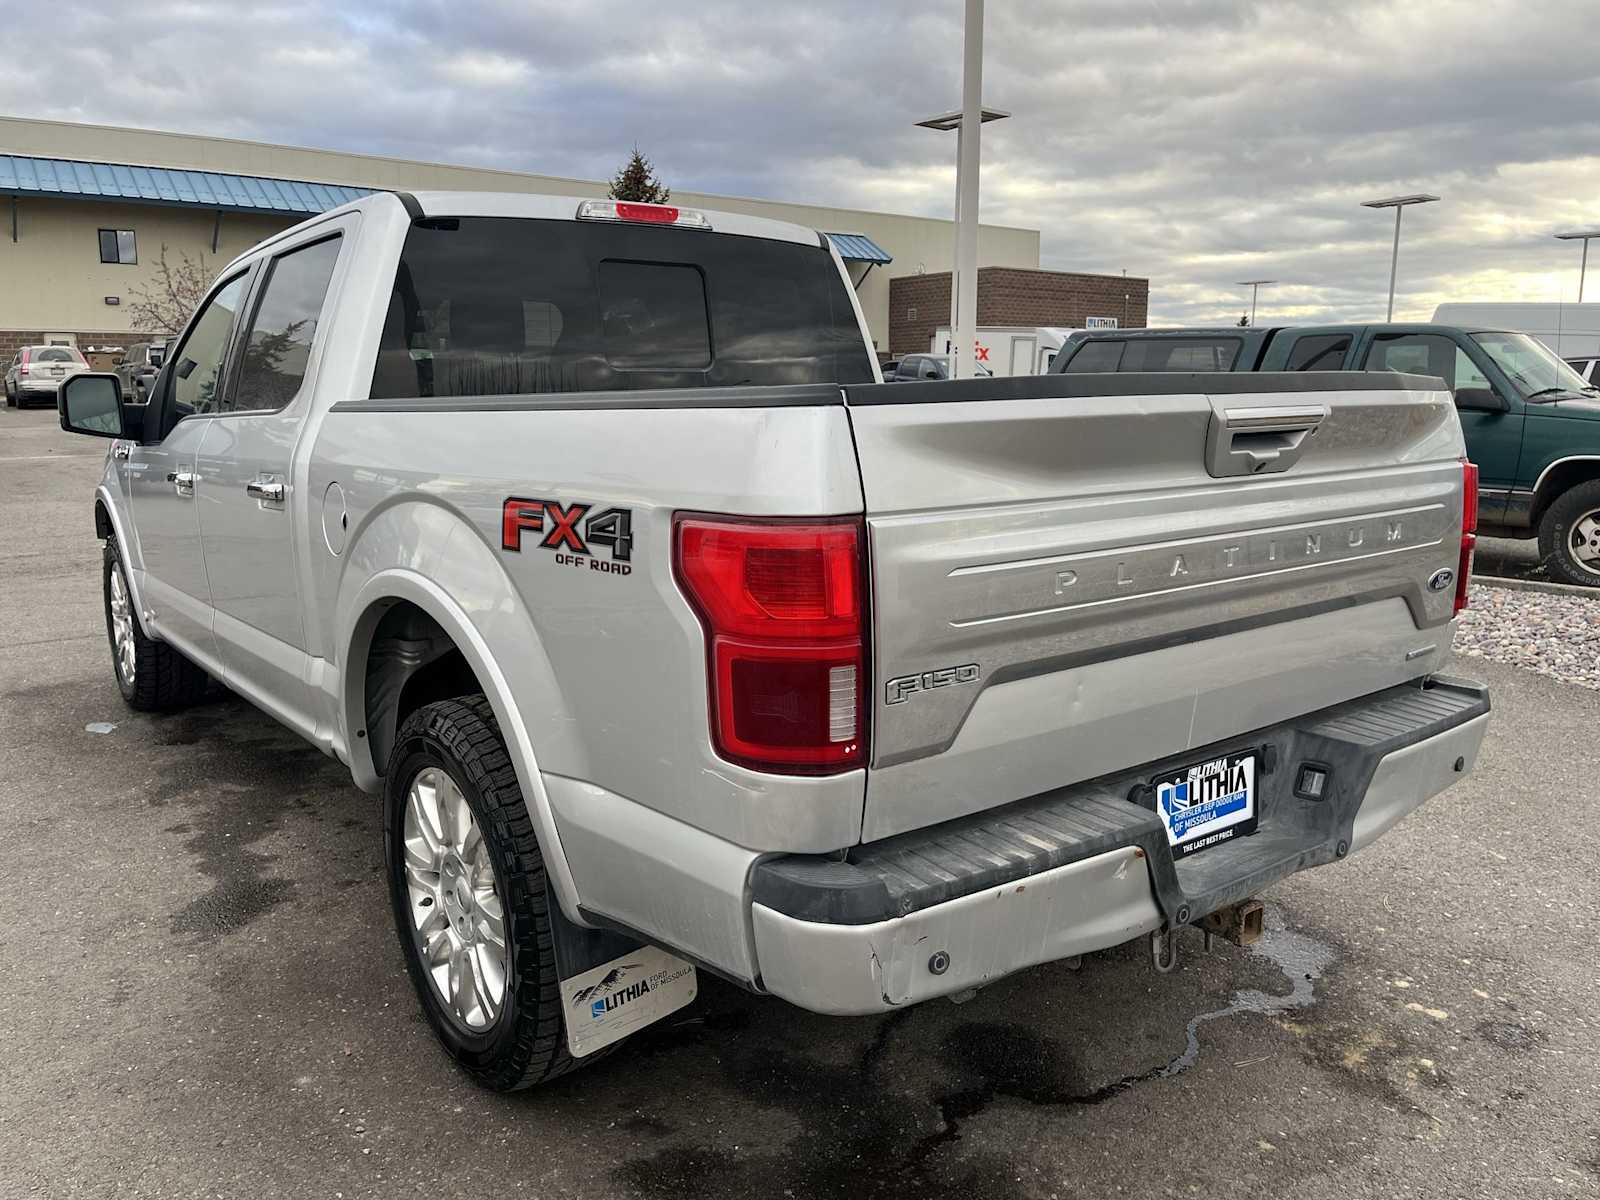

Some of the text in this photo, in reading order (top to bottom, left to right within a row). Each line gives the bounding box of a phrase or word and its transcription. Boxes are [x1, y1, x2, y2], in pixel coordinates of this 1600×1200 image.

[1094, 319, 1116, 329] LITHIA
[502, 496, 633, 562] FX4
[555, 553, 632, 576] OFF ROAD
[1055, 522, 1402, 594] PLATINUM
[1197, 758, 1228, 779] LITHIA
[1189, 765, 1248, 808] LITHIA
[1174, 806, 1202, 822] CHRYSLER
[1202, 801, 1216, 812] JEEP
[1174, 810, 1217, 832] OF MISSOULA
[1182, 829, 1234, 853] THE LAST BEST PRICE
[649, 970, 668, 982] FORD
[650, 965, 692, 991] OF MISSOULA
[605, 979, 650, 1012] LITHIA
